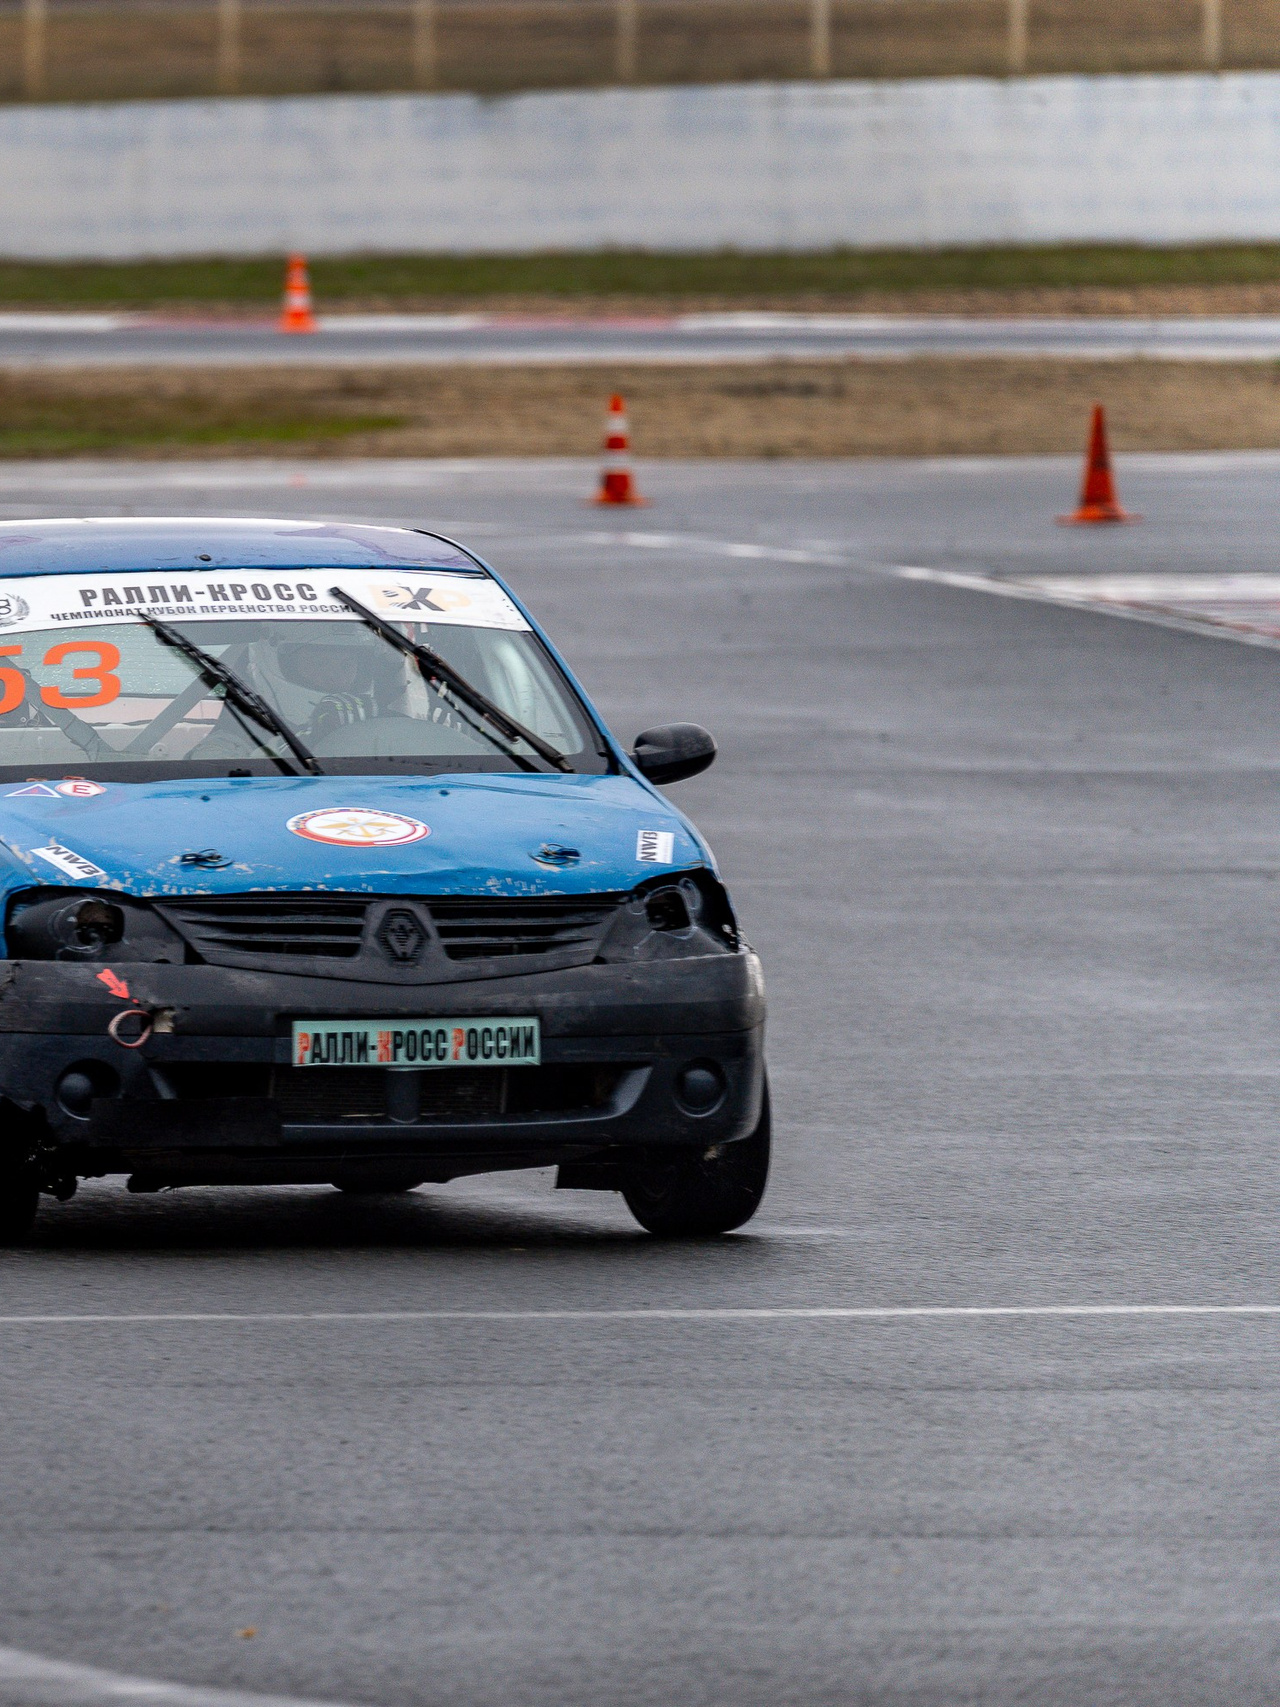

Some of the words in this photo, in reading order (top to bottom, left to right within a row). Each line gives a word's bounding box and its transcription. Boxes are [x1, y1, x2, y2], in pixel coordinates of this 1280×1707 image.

[78, 583, 318, 607] РАЛЛИ-КРОСС
[50, 607, 143, 621] ЧЕМПИОНАТ
[147, 605, 197, 616] КУБОК
[201, 604, 296, 613] ПЕРВЕНСТВО
[299, 604, 358, 612] РОССИ
[72, 784, 91, 795] E
[297, 1029, 450, 1064] РАЛЛИ-КРОСС
[452, 1025, 536, 1061] РОССИИ
